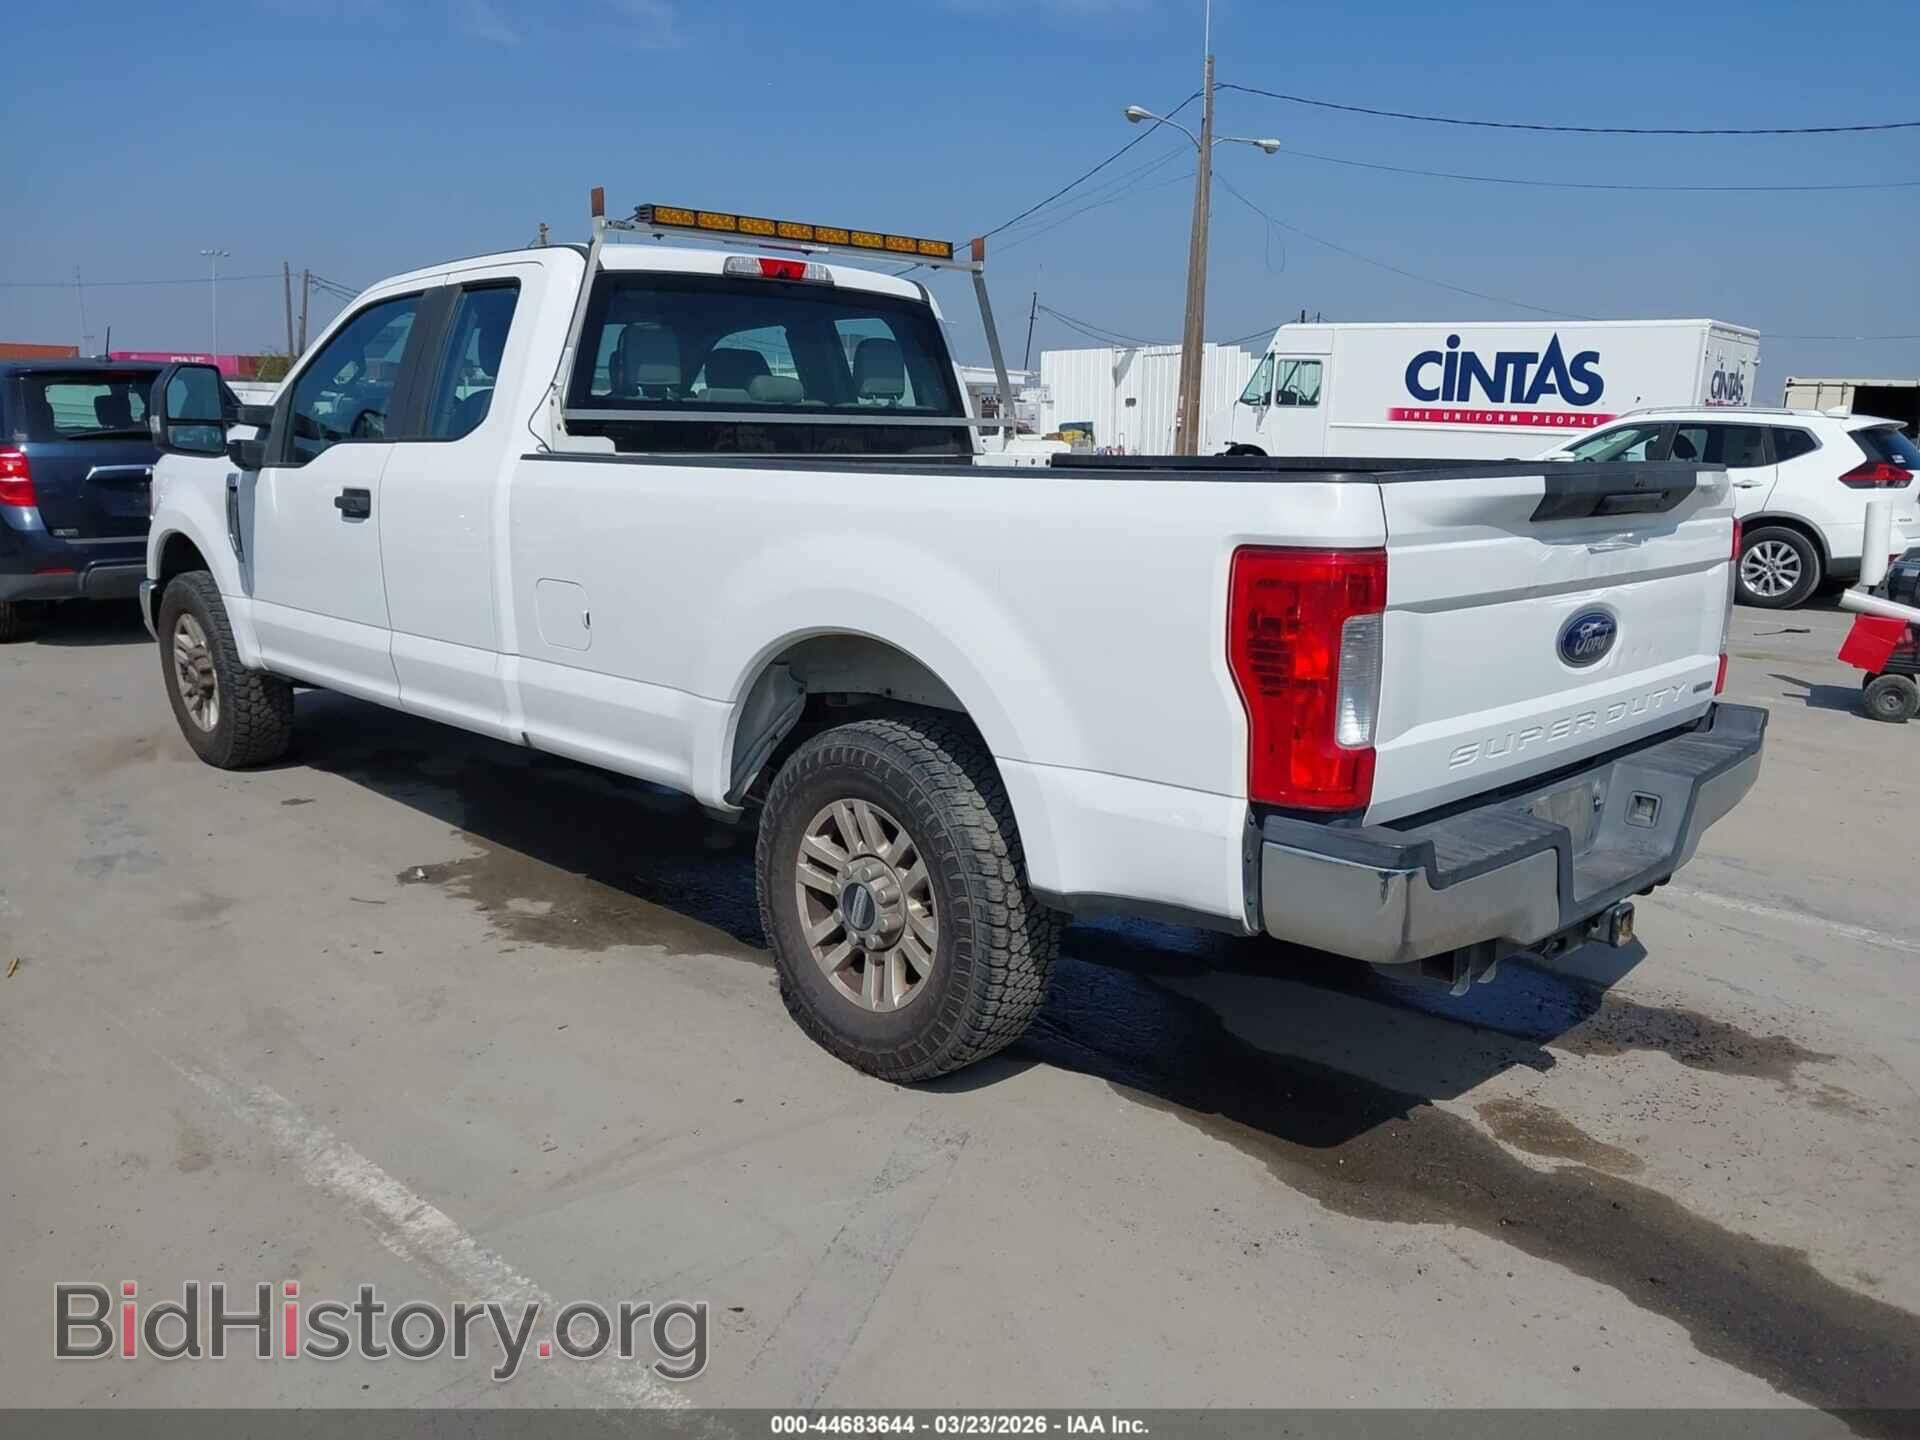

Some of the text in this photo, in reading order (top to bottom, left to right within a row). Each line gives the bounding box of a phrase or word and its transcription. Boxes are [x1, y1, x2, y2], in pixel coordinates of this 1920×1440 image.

[1403, 410, 1599, 426] THE UNIFORM PEOPLE
[1449, 681, 1688, 770] SUPER DUTY
